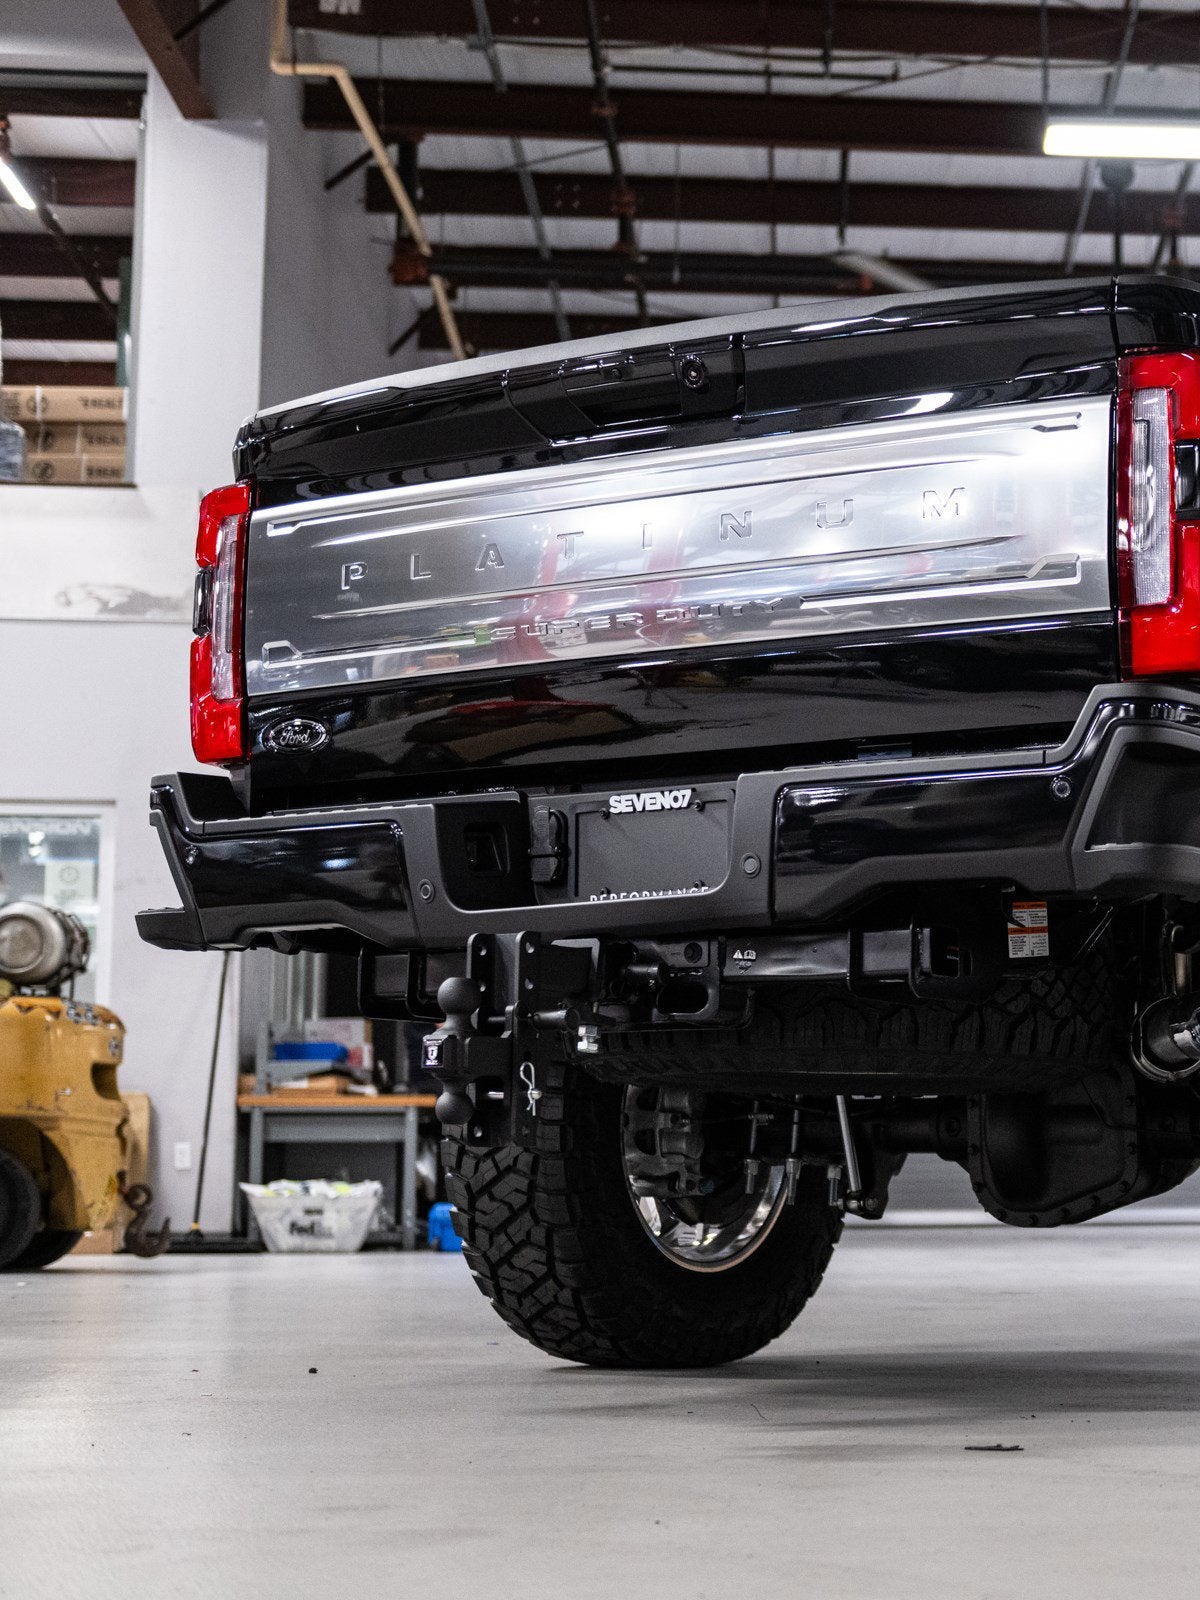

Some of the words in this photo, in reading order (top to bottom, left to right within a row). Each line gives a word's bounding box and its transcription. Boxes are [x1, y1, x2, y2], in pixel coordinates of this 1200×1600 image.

[339, 485, 965, 591] PLATINUM
[489, 612, 644, 641] SUPER
[656, 597, 784, 623] DUTY
[279, 725, 311, 746] Ford
